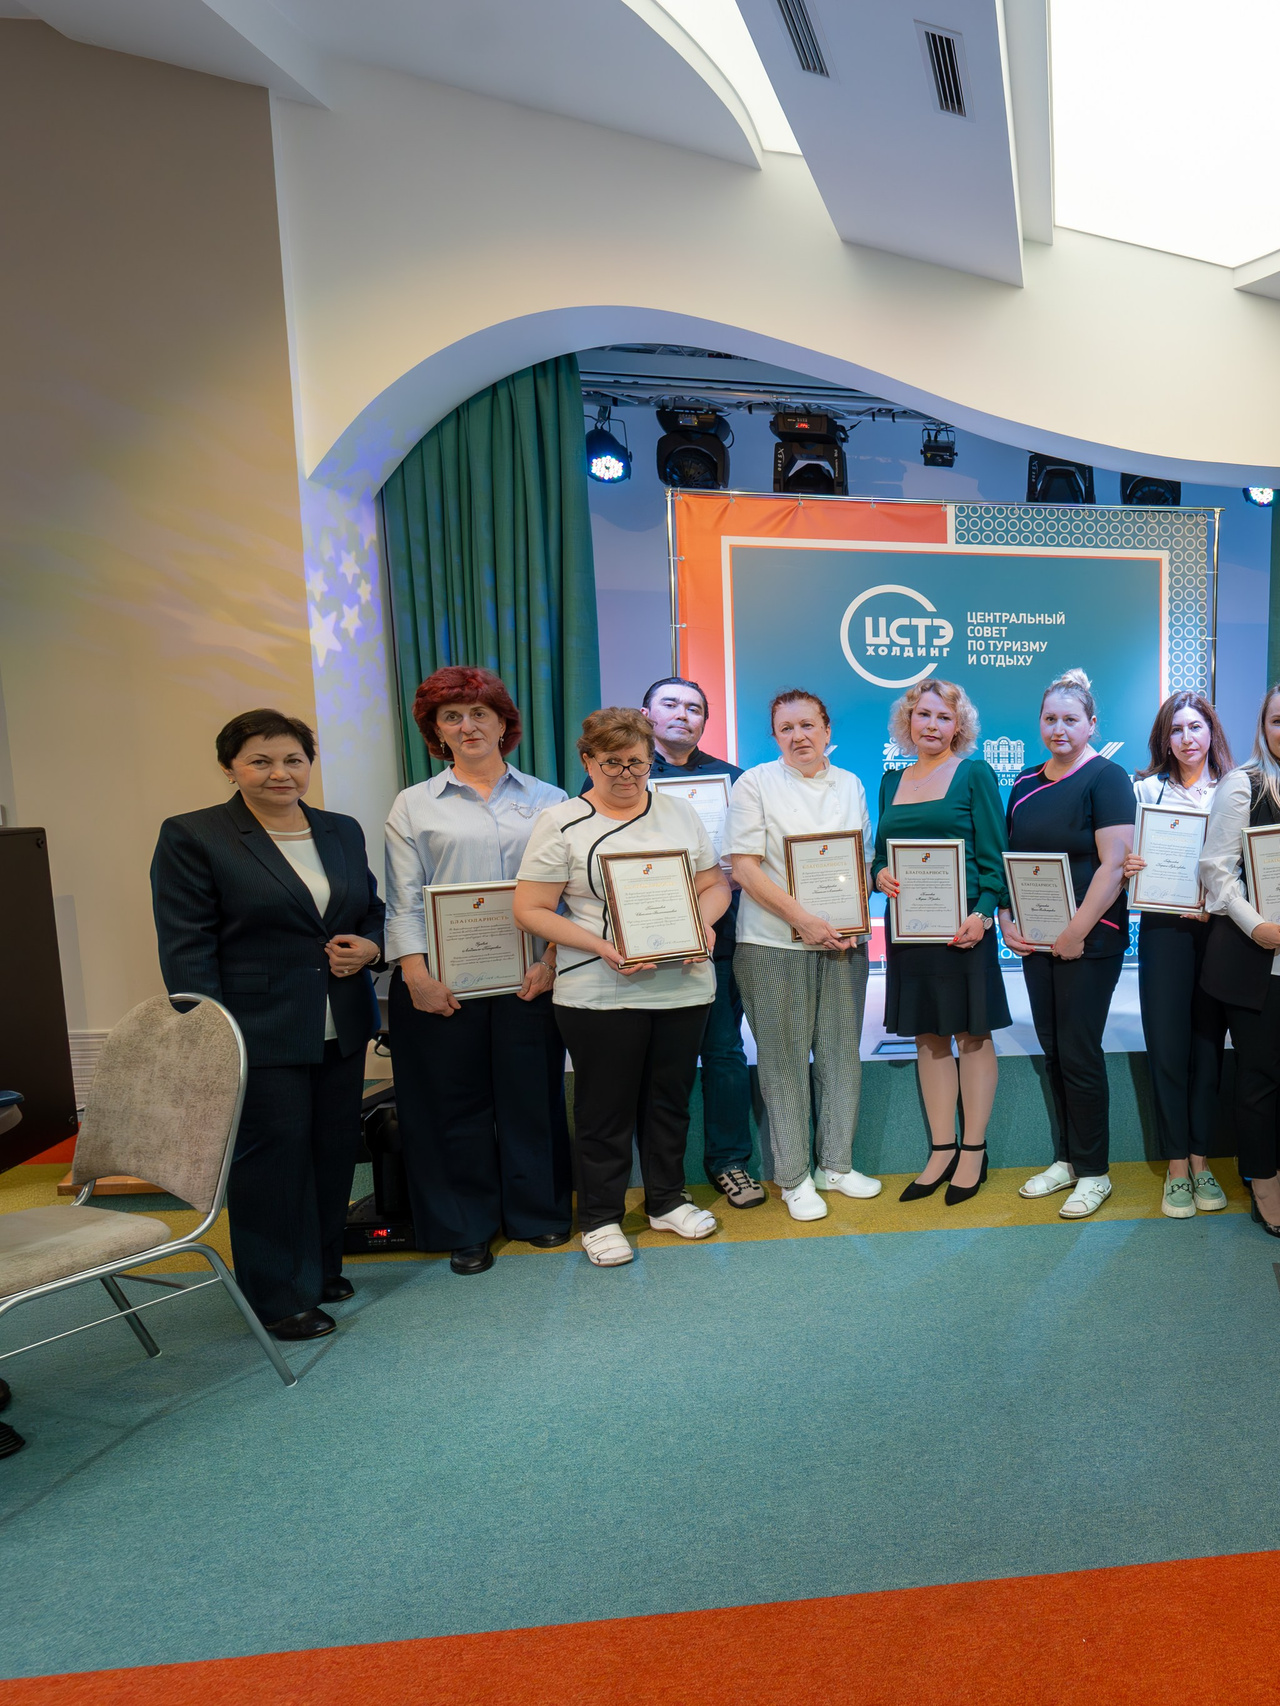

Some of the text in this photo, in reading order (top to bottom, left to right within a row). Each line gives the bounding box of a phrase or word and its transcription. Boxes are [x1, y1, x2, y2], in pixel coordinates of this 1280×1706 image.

[967, 611, 1066, 625] ЦЕНТРАЛЬНЫЙ
[865, 616, 954, 646] ЦСТЭ
[967, 626, 1008, 638] СОВЕТ
[866, 645, 950, 658] ХОЛДИНГ
[967, 640, 1048, 653] ПО ТУРИЗМУ
[968, 654, 1033, 667] И ОТДЫХУ
